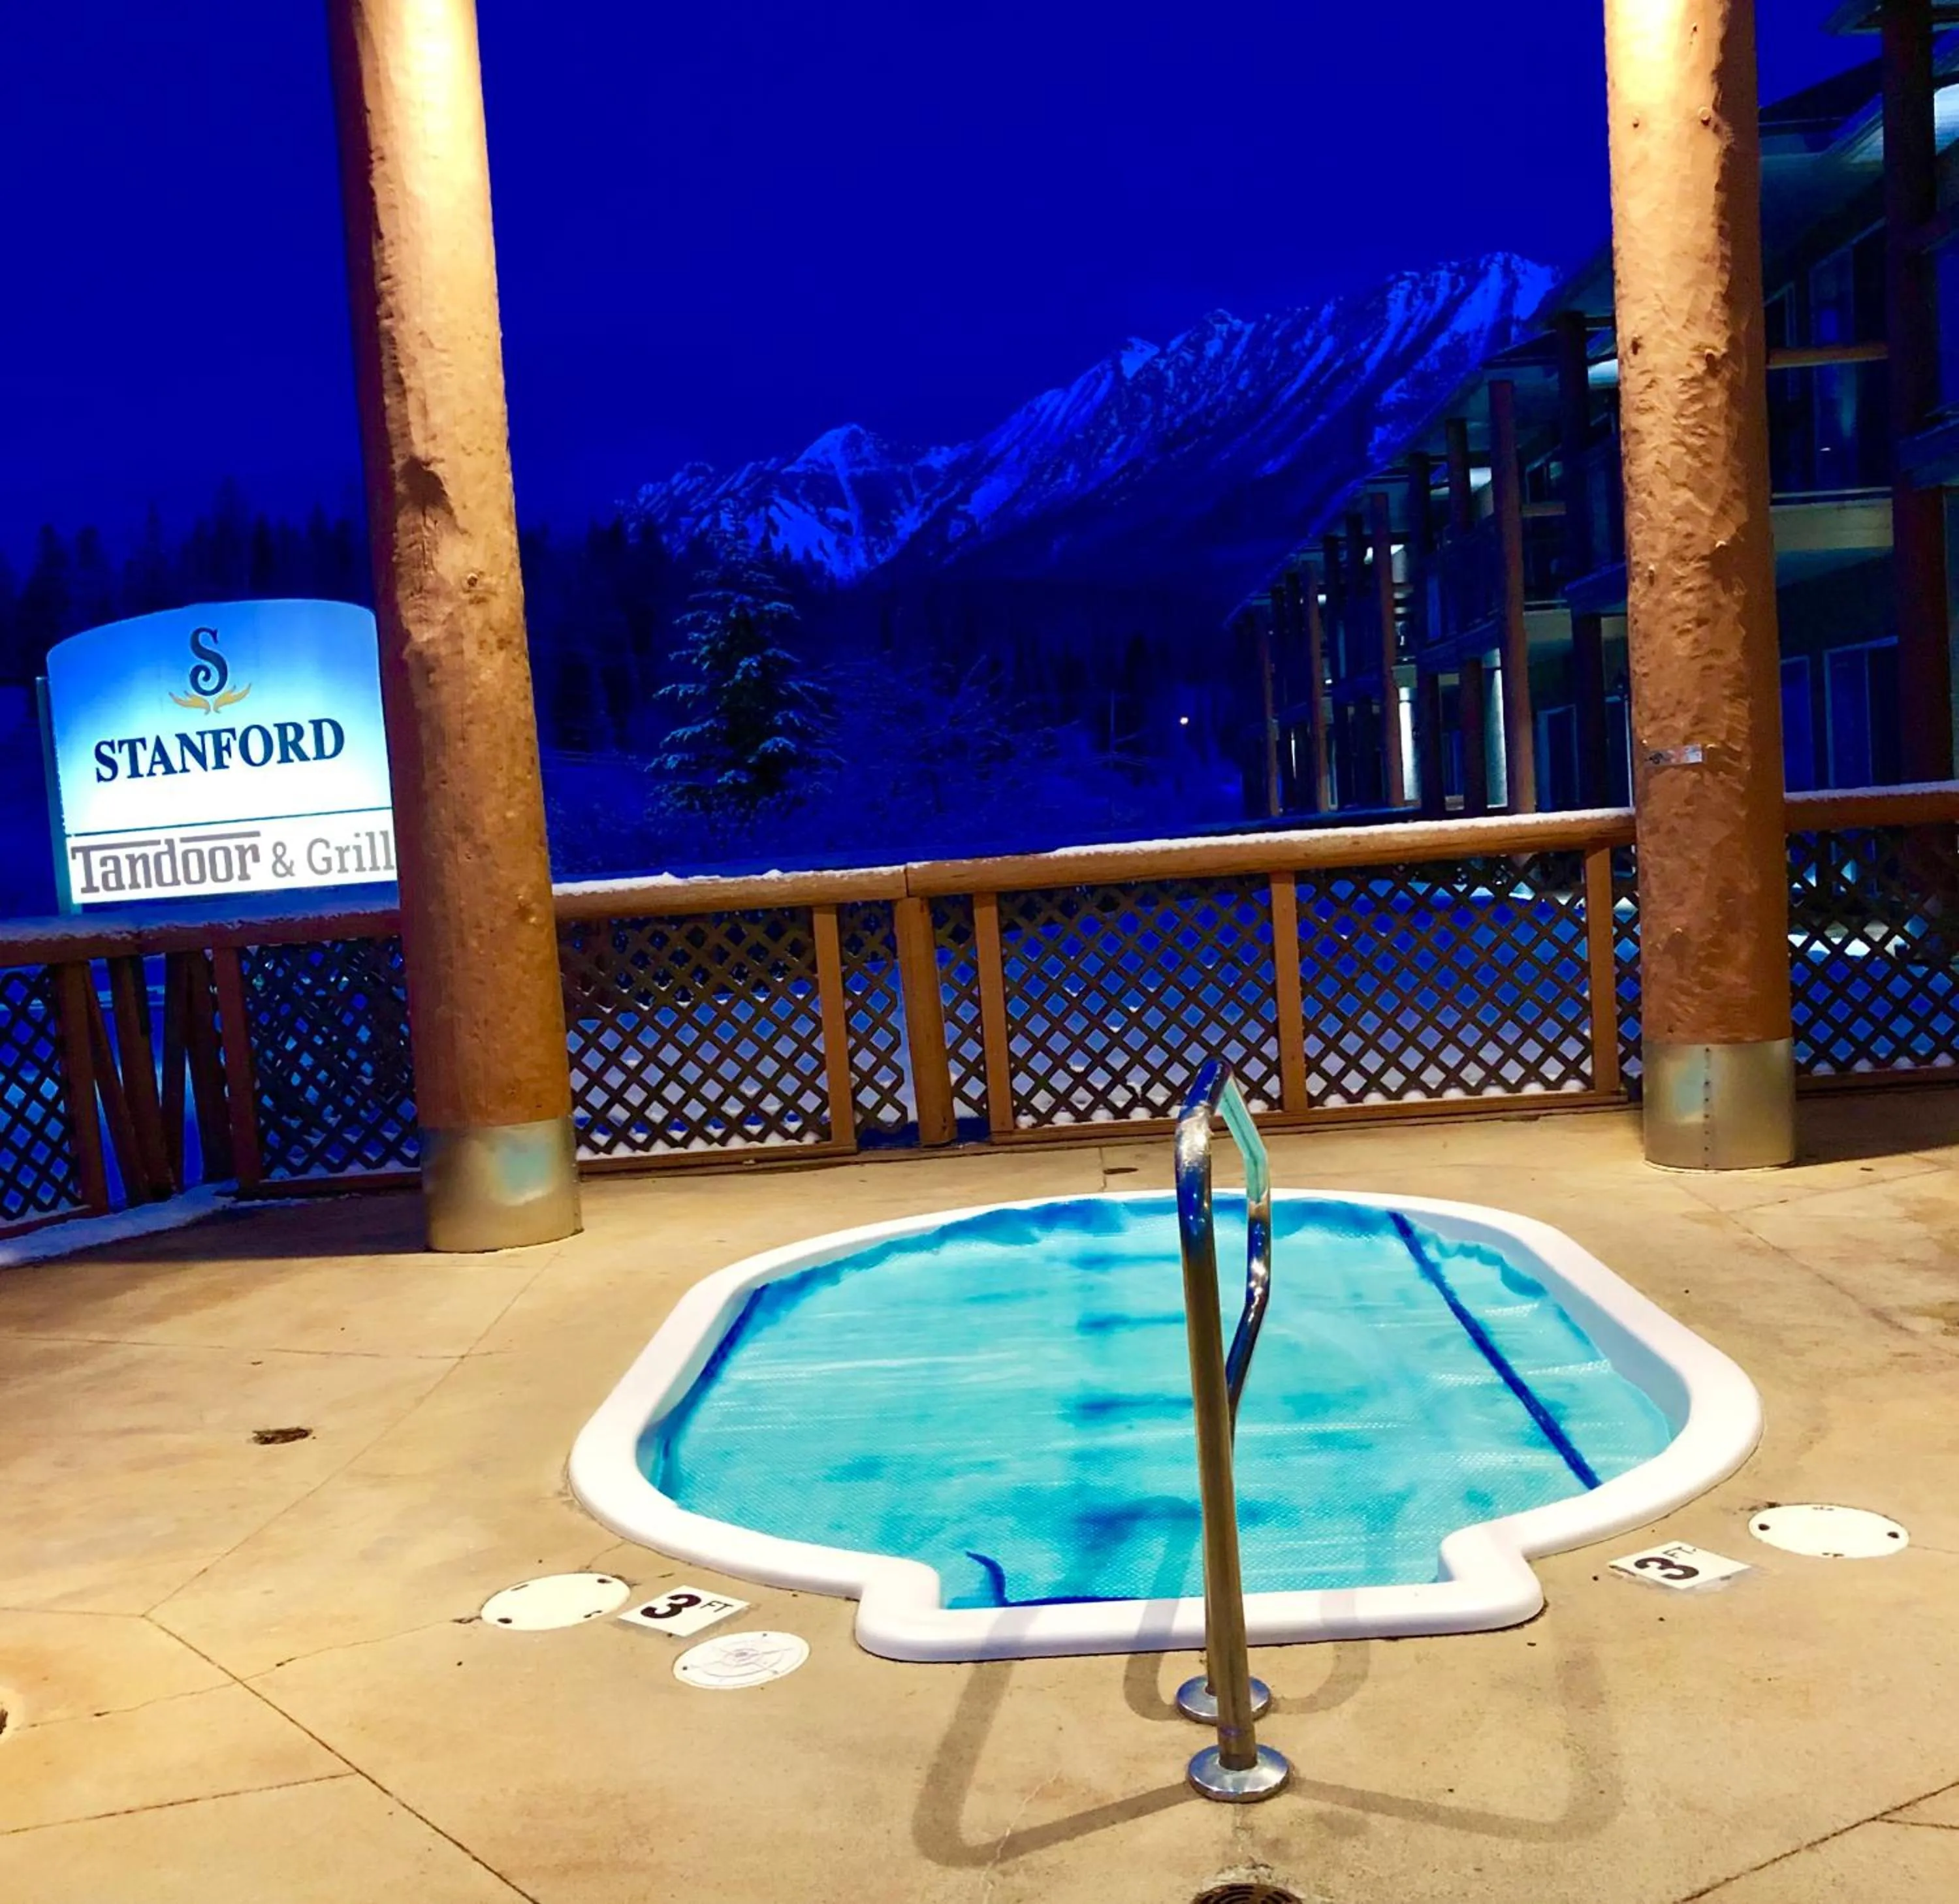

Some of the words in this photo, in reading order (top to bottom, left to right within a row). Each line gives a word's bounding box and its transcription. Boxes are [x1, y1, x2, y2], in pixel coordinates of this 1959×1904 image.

[95, 718, 344, 782] STANFORD
[71, 831, 261, 893] Tandoor
[271, 841, 295, 878] &
[307, 831, 394, 876] Grill
[1634, 1557, 1699, 1580] 3
[641, 1594, 701, 1619] 3
[699, 1600, 733, 1613] FT
